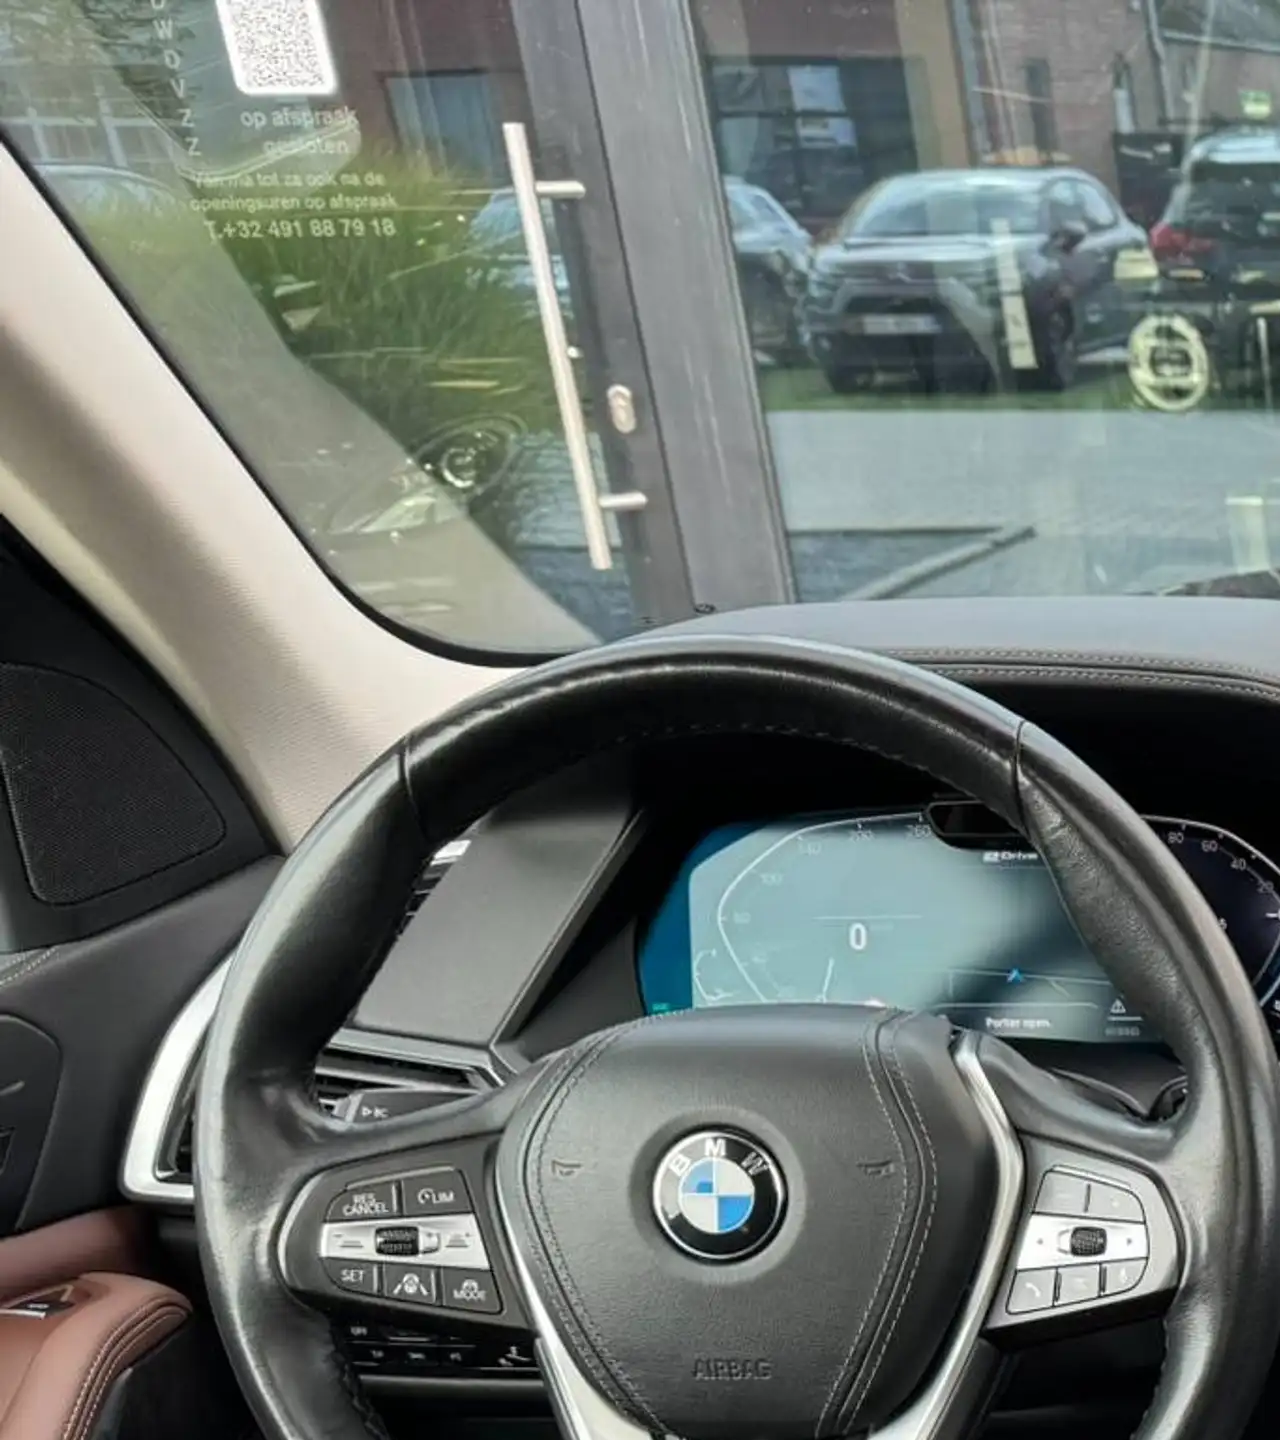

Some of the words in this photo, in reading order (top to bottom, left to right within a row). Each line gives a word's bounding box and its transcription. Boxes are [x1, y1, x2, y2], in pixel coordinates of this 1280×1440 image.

[267, 219, 303, 237] 491
[309, 218, 336, 237] 88
[338, 218, 366, 237] 79
[369, 217, 397, 237] 18
[1167, 832, 1184, 844] 80
[1230, 858, 1247, 871] 40
[850, 922, 867, 950] 0
[668, 1138, 769, 1176] BMW
[342, 1203, 389, 1217] CANCEL
[341, 1269, 364, 1282] SET
